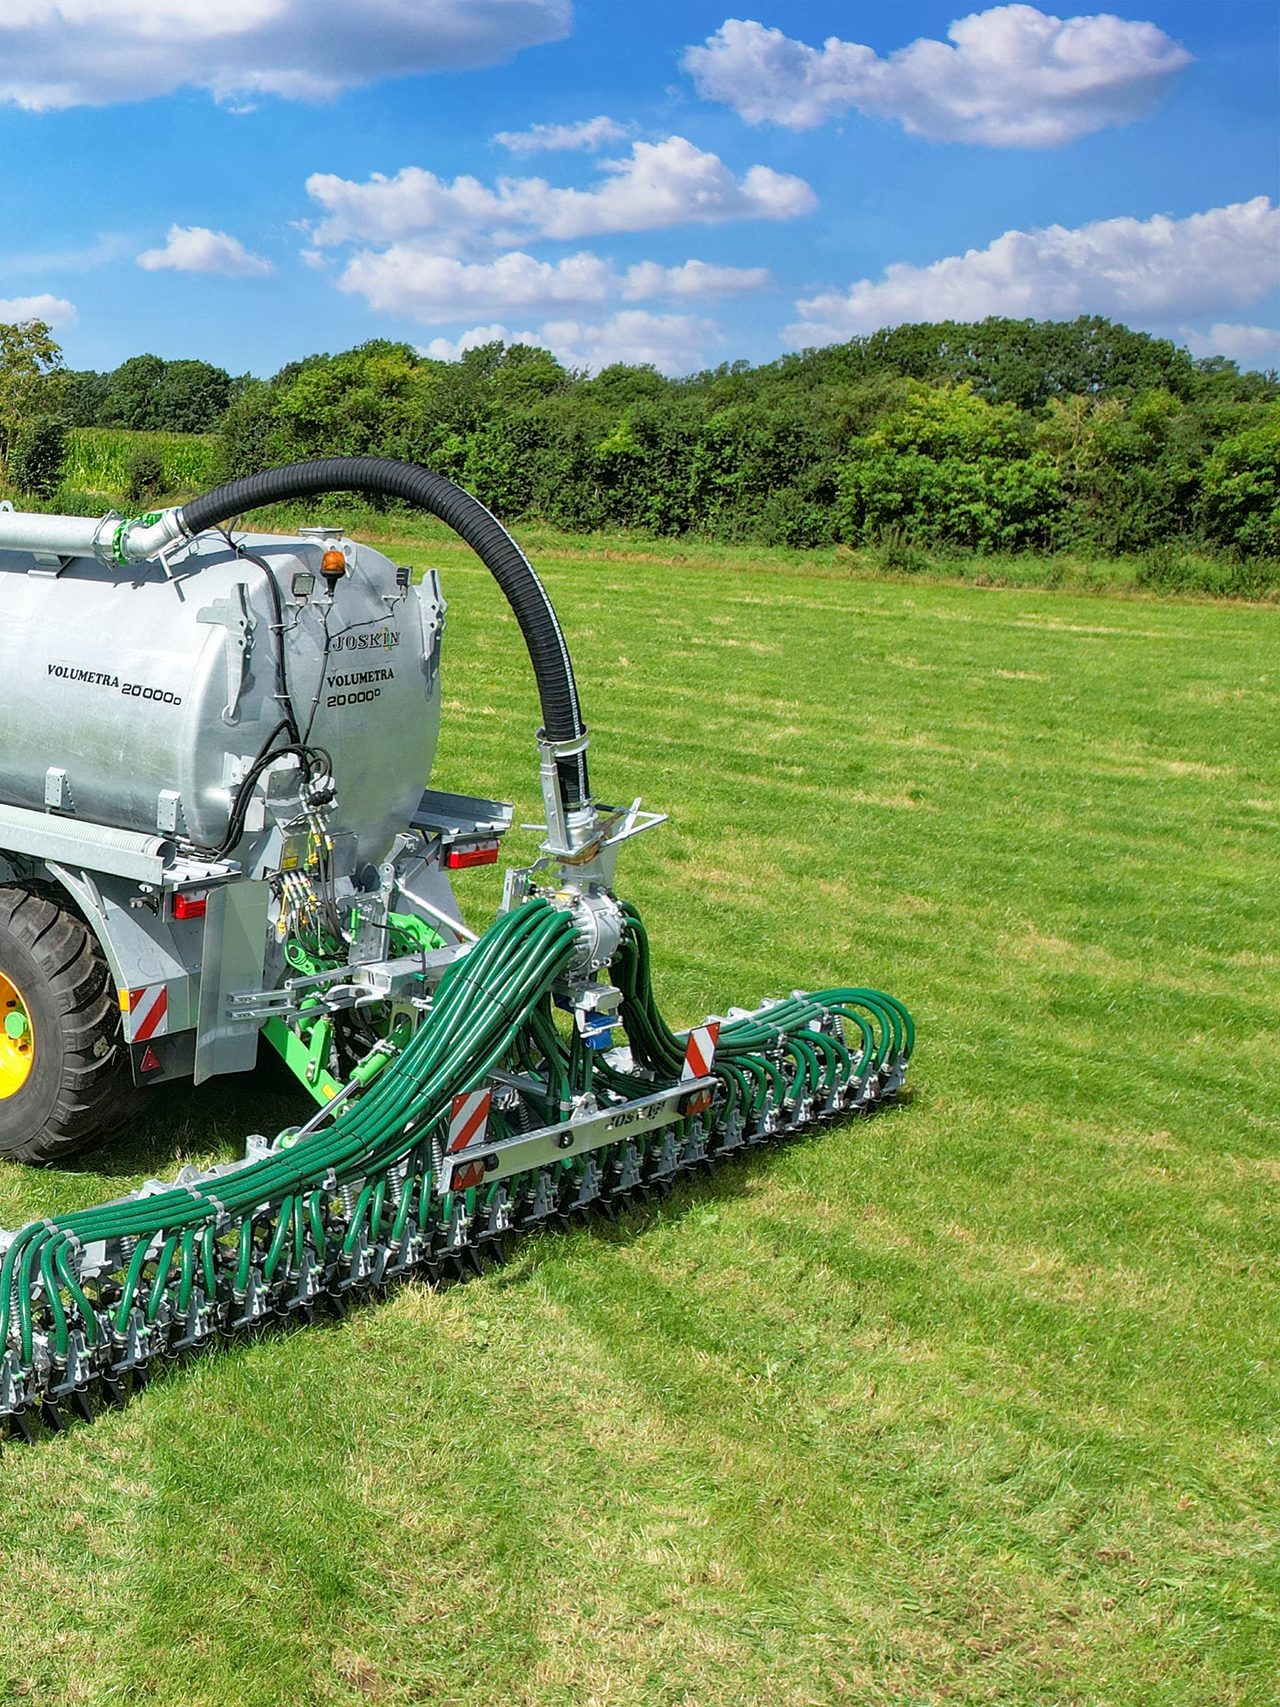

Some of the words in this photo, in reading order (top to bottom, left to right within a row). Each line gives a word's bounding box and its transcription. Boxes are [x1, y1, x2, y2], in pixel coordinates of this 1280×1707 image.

[332, 630, 401, 652] JOSKIN
[47, 664, 120, 688] VOLUMETRA
[327, 667, 395, 689] VOLUMETRA
